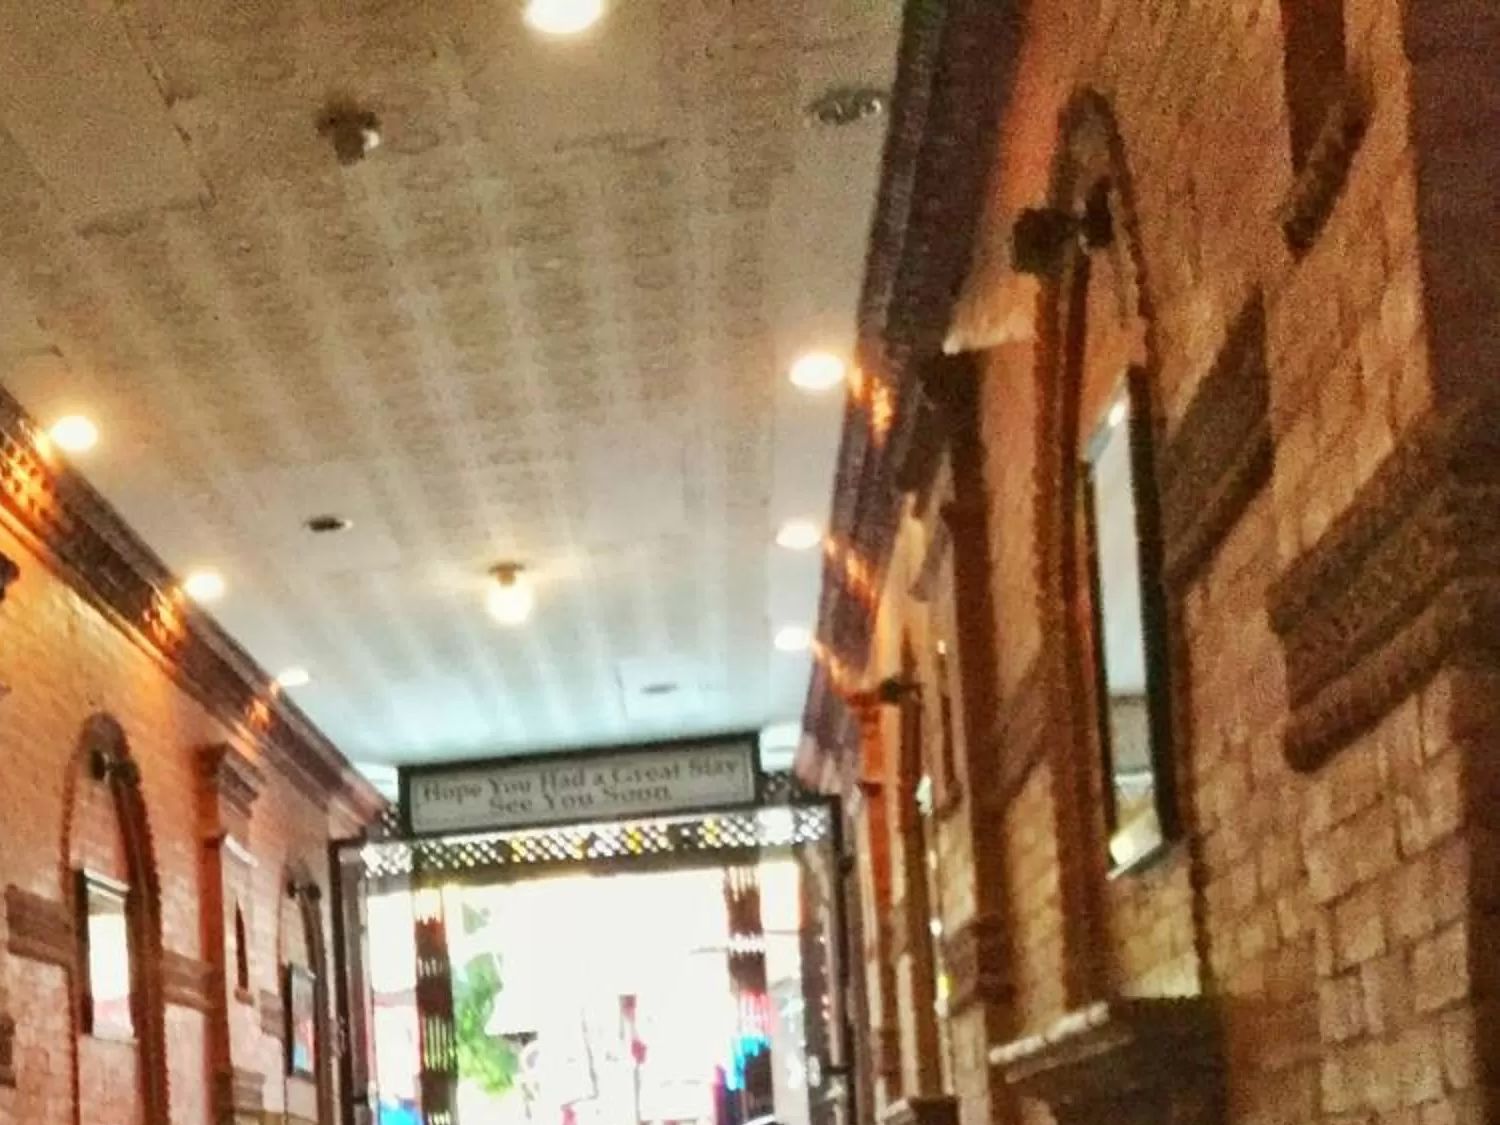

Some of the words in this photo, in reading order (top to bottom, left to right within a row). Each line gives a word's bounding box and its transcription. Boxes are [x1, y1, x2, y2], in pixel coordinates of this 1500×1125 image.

[424, 780, 482, 804] Hope
[488, 776, 532, 796] You
[540, 767, 586, 792] Had
[542, 792, 596, 810] You
